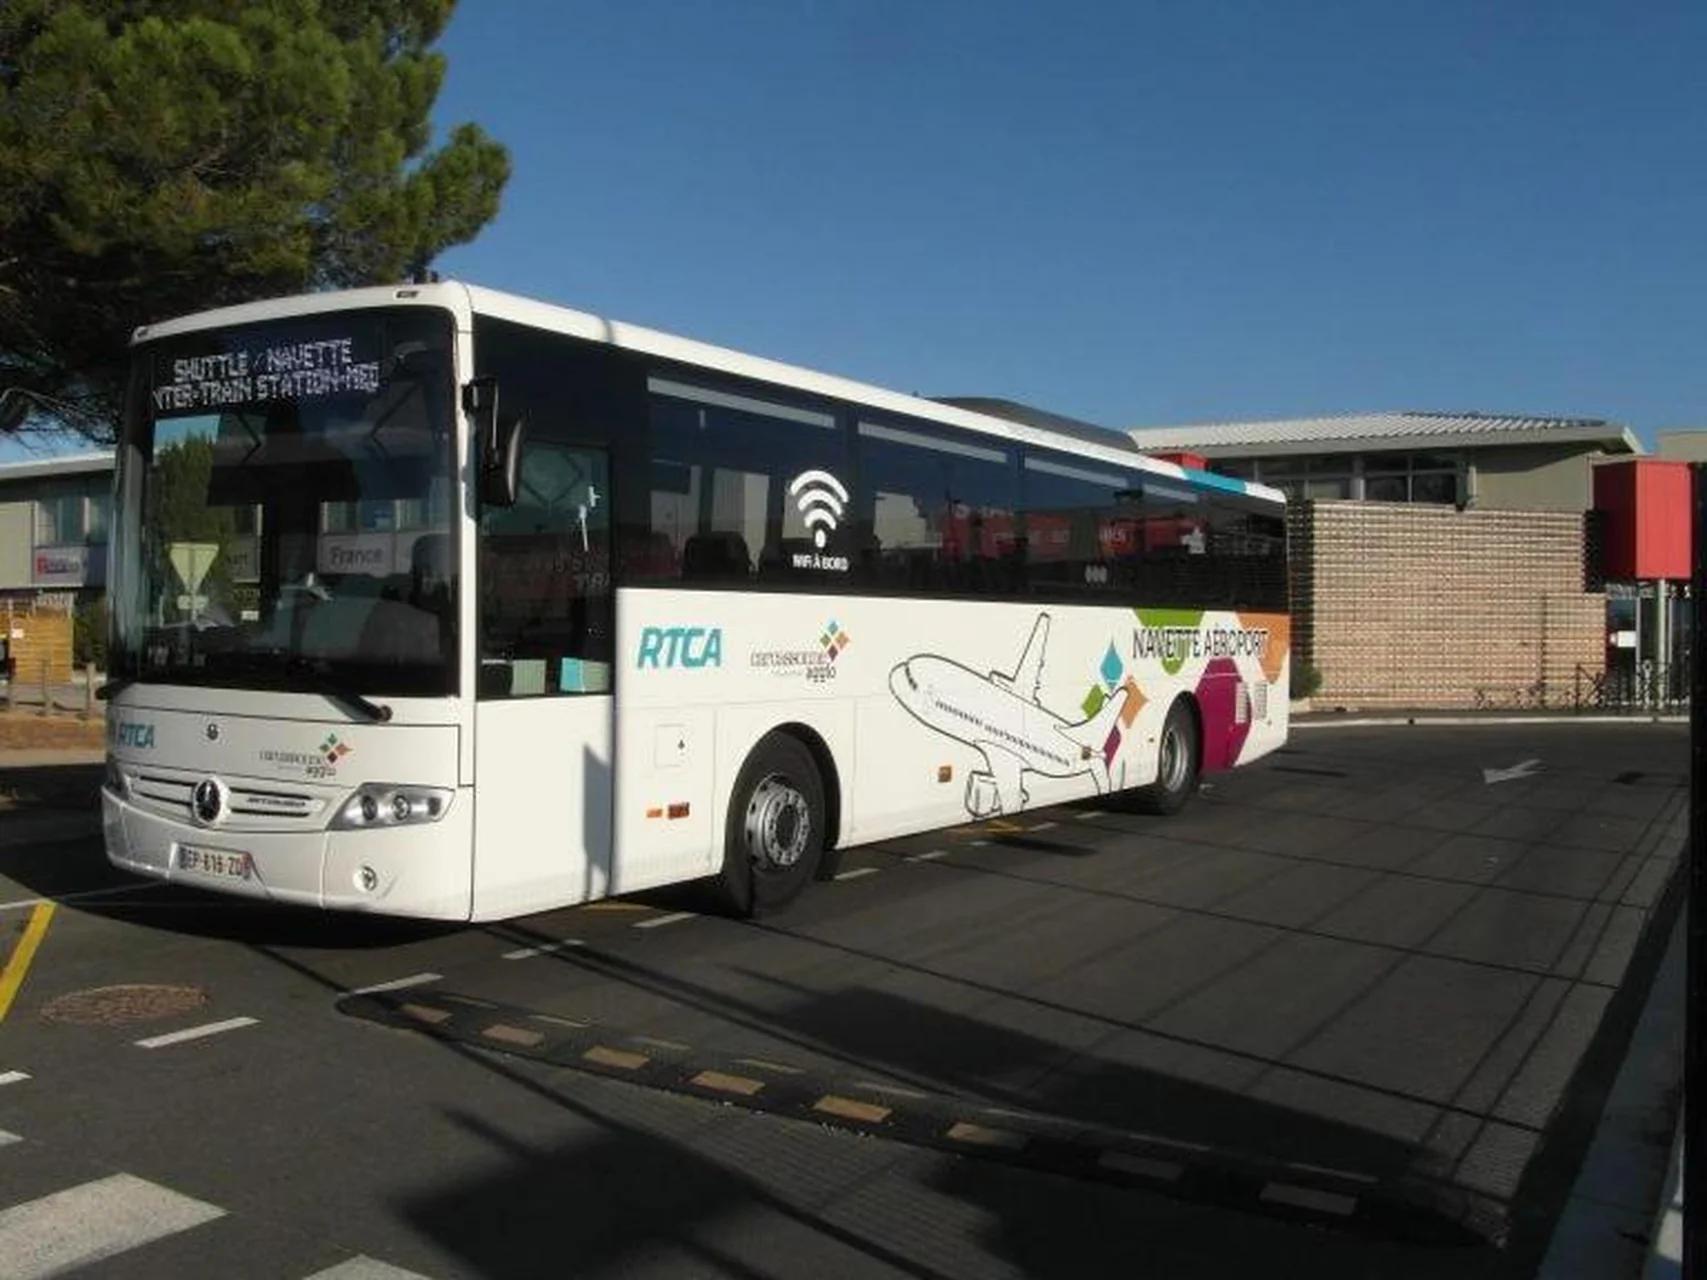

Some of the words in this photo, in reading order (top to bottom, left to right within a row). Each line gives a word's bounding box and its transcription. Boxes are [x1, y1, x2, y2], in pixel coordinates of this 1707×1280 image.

[637, 626, 722, 669] RTCA
[1133, 628, 1200, 659] NAVETTE
[117, 722, 155, 748] RTCA
